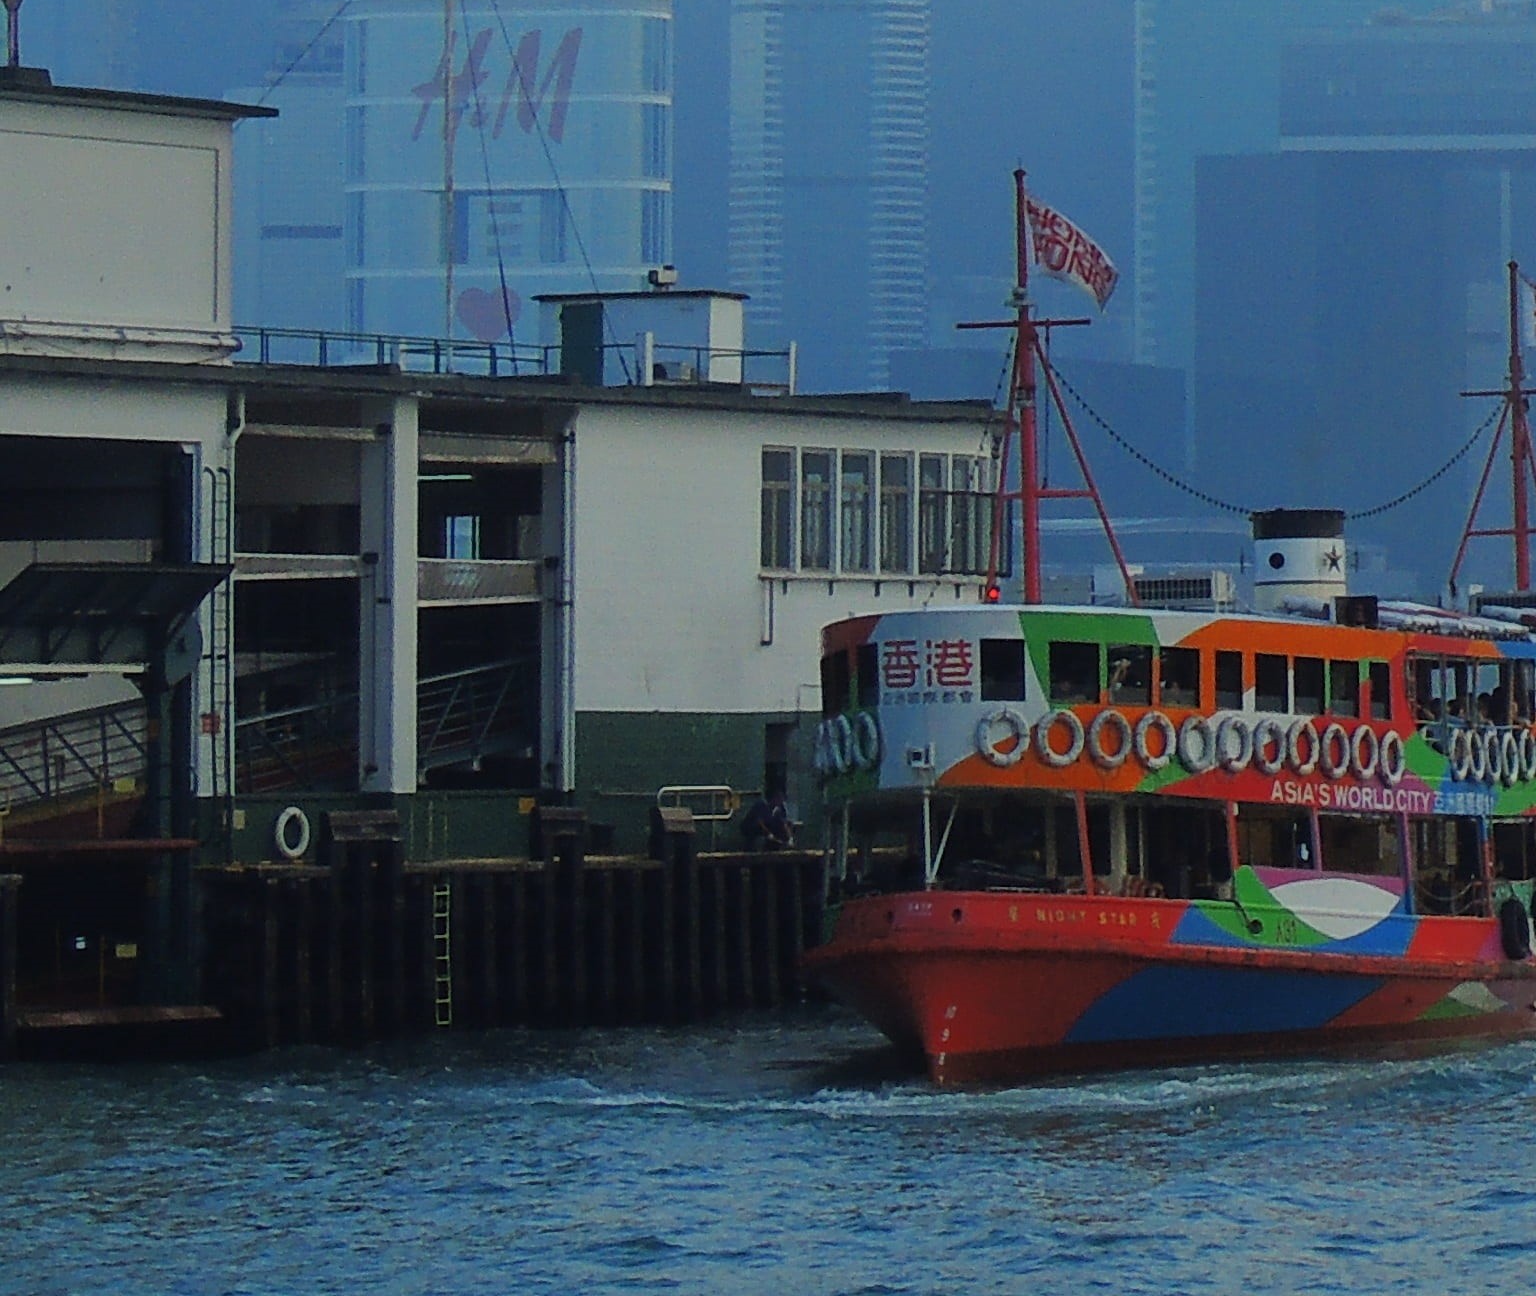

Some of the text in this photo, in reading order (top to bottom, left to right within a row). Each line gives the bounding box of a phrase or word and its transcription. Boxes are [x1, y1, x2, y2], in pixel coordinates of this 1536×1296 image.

[882, 640, 973, 688] 香港
[1334, 785, 1394, 811] WORLD
[1397, 790, 1432, 812] CITY
